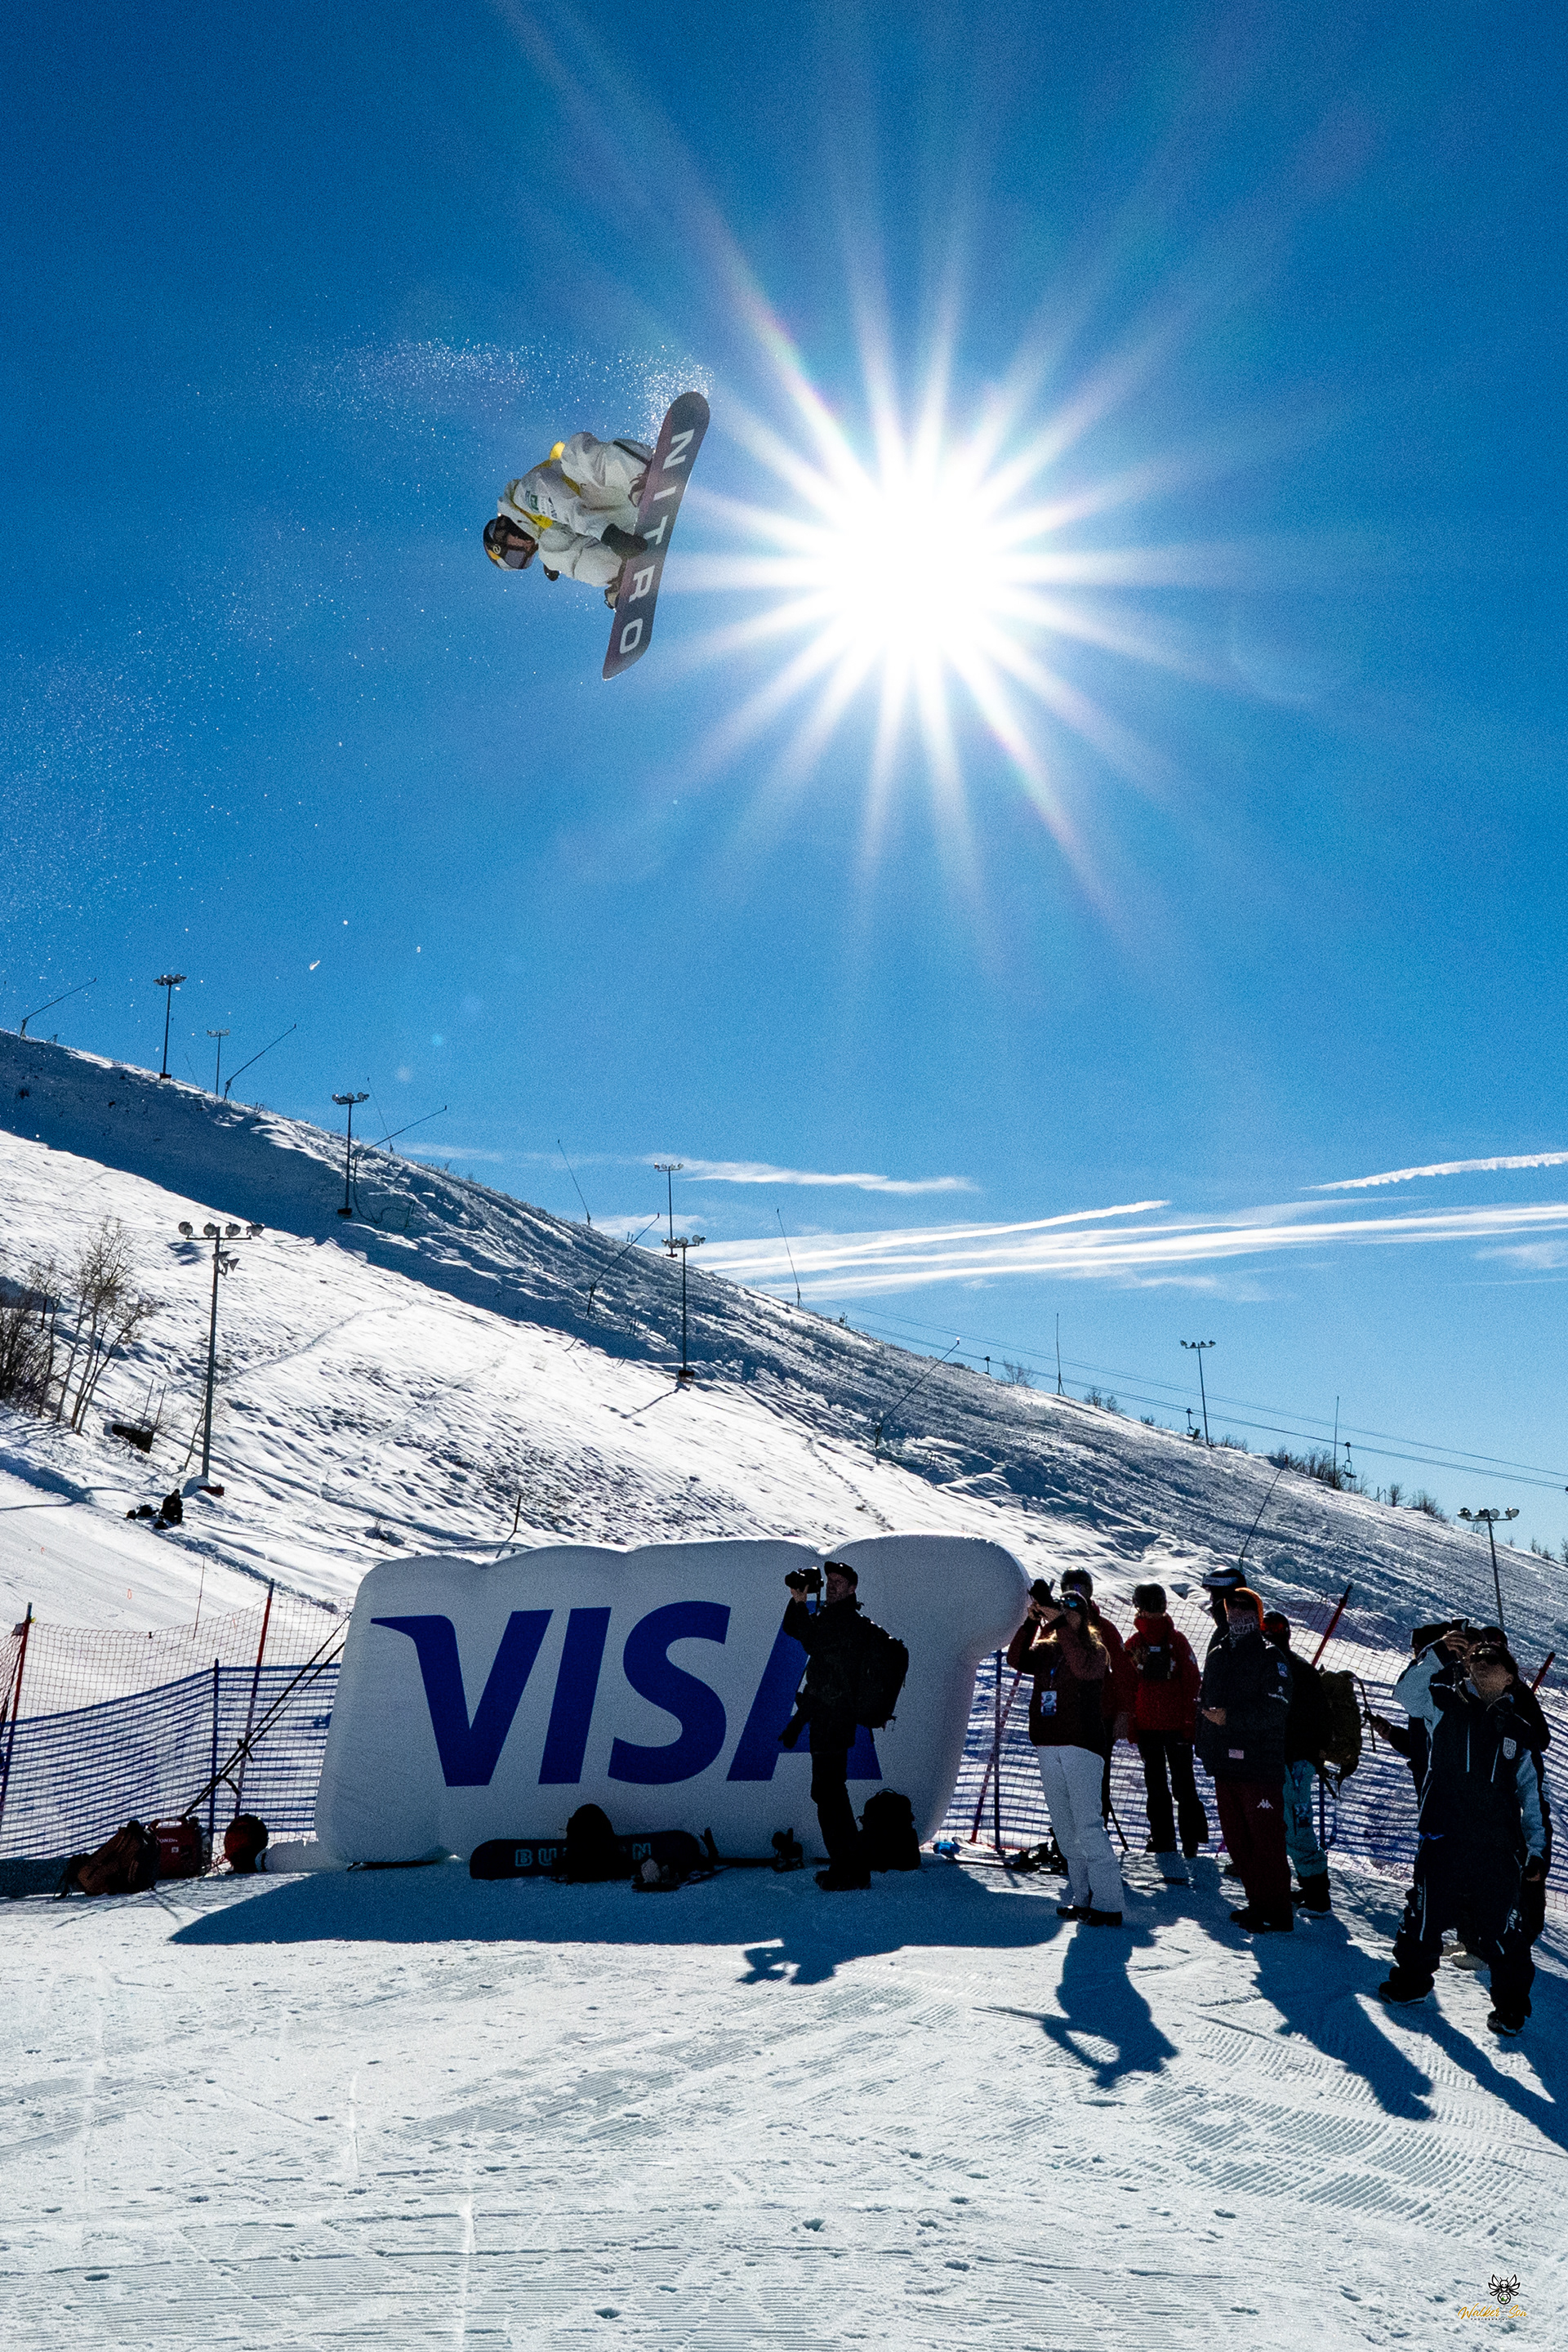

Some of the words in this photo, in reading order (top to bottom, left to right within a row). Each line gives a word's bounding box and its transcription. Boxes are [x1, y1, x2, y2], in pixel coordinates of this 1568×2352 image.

[619, 429, 694, 653] NITRO
[370, 1601, 882, 1787] VISA
[514, 1842, 652, 1867] BUN
